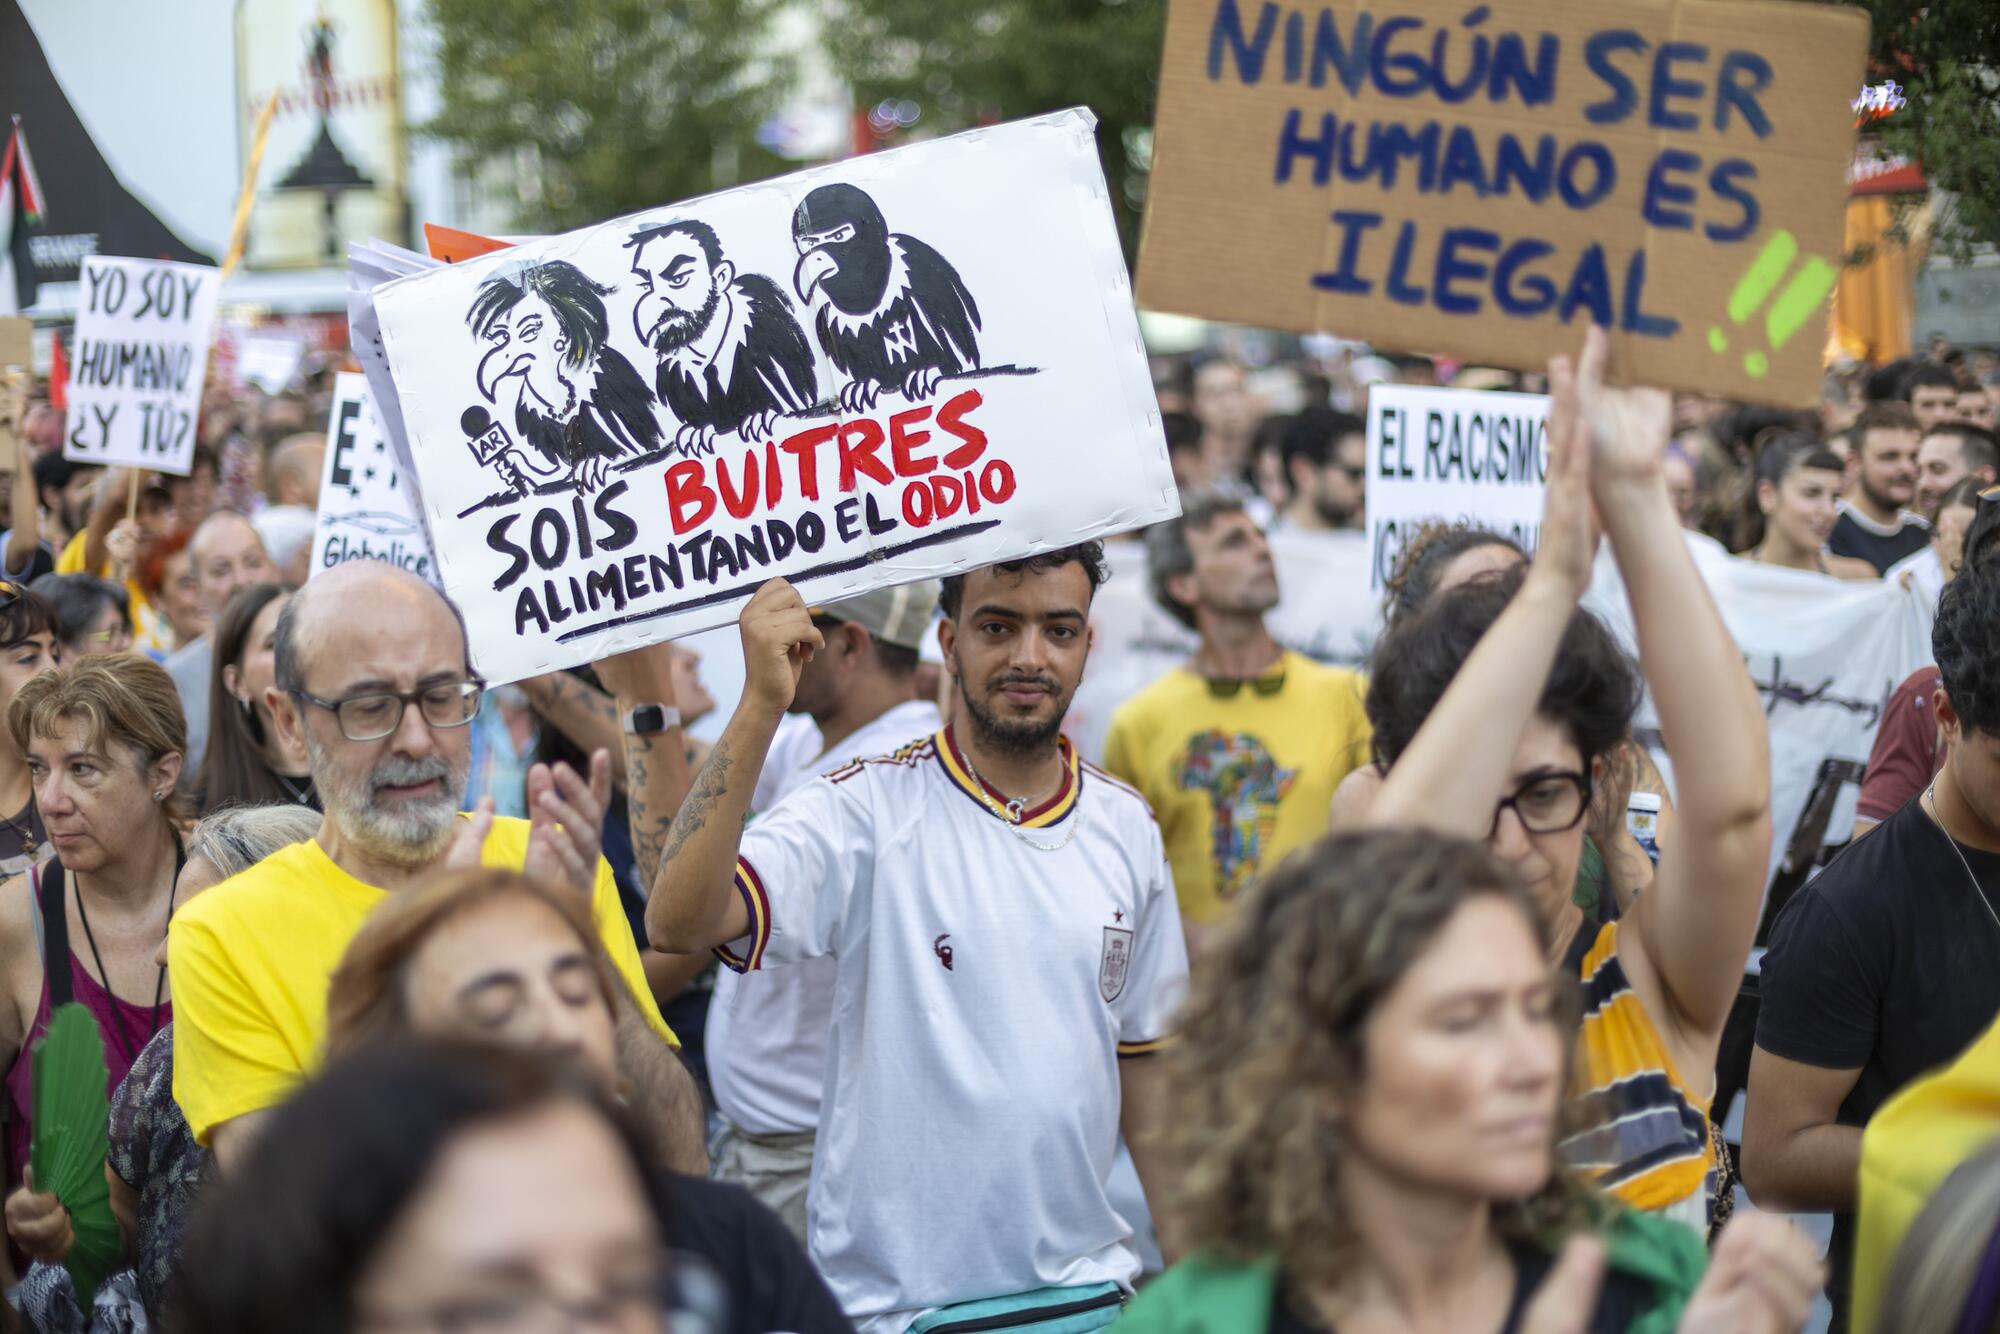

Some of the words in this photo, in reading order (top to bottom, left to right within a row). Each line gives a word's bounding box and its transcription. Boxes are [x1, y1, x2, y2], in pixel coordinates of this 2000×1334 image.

[1206, 0, 1560, 107] NINGÚN
[1583, 29, 1774, 139] SER
[1274, 108, 1617, 210] HUMANO
[1642, 149, 1760, 242] ES
[87, 265, 127, 315] YO
[134, 268, 202, 321] SOY
[1310, 210, 1680, 338] ILEGAL
[77, 339, 193, 392] HUMANO
[71, 402, 119, 449] ¿Y
[480, 430, 505, 459] AR
[1380, 409, 1413, 478] EL
[486, 480, 639, 592] SOIS
[663, 388, 989, 535] BUITRES
[514, 511, 826, 636] ALIMENTANDO
[833, 492, 900, 543] EL
[901, 459, 1017, 528] ODIO
